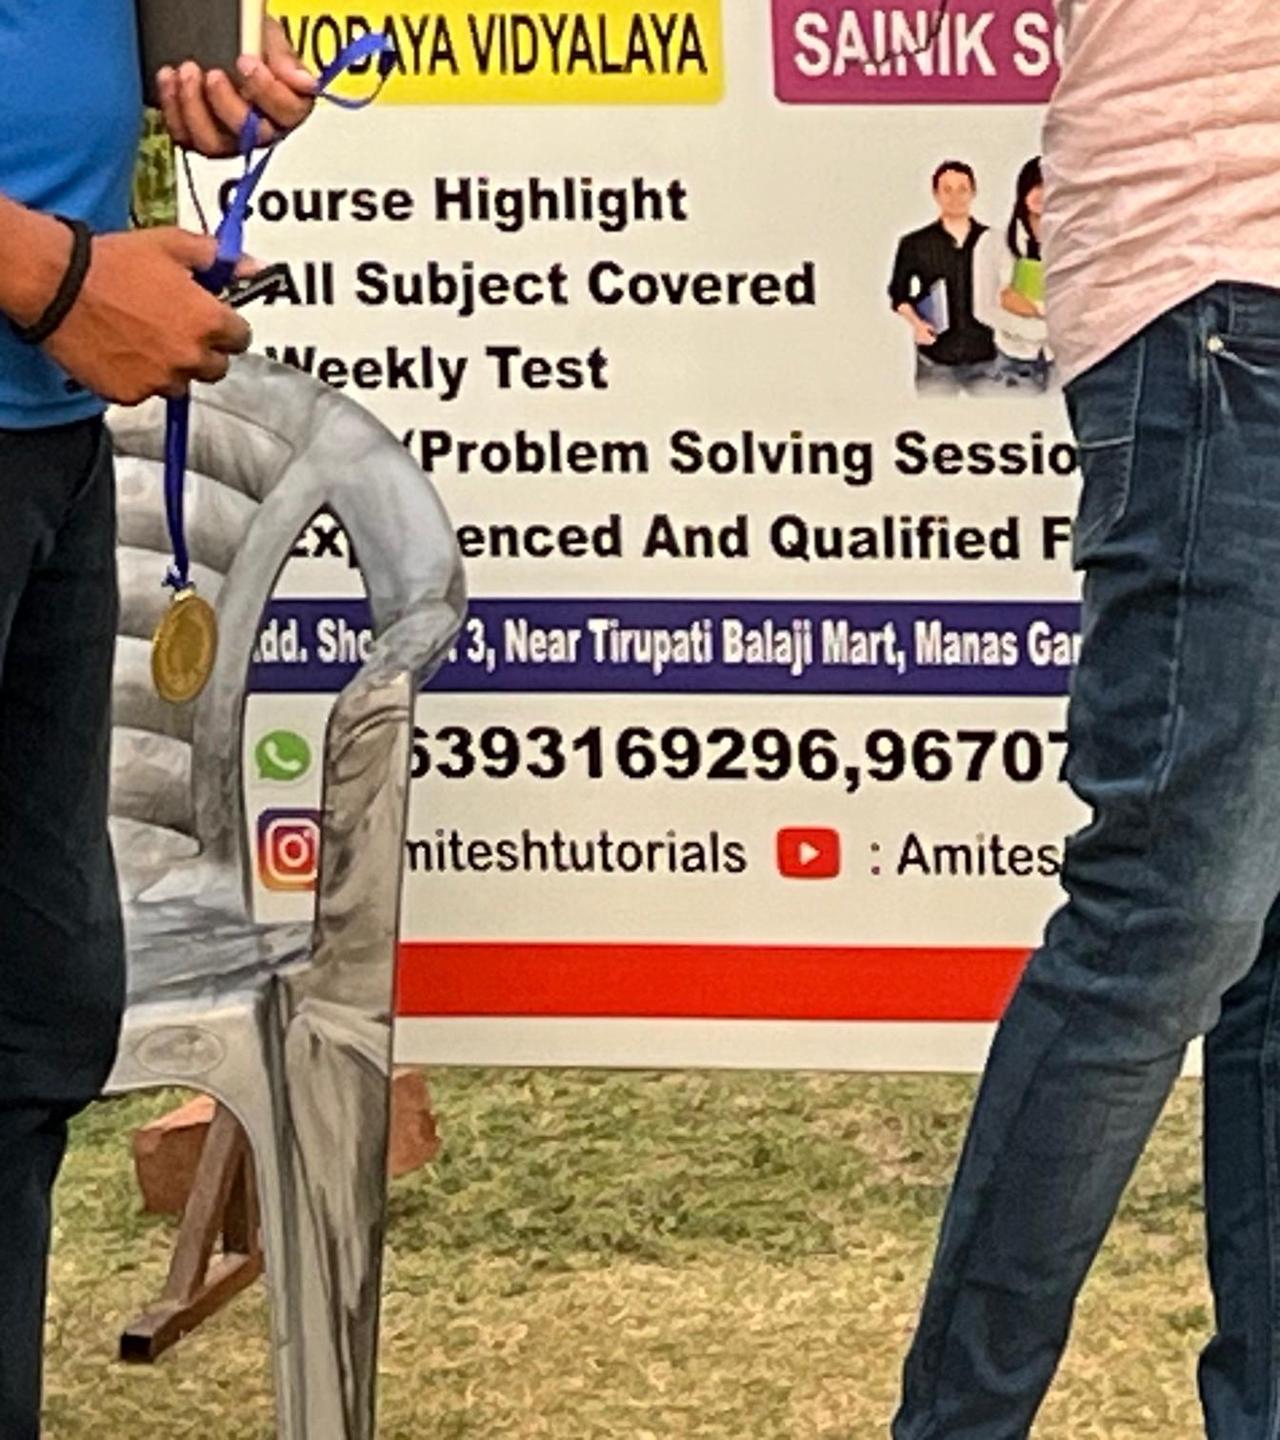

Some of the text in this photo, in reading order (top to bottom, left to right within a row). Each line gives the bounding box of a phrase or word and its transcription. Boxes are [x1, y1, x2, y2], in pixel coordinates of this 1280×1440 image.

[470, 13, 707, 75] VIDYALAYA
[794, 9, 1064, 76] SAINIK S
[218, 176, 687, 232] Course Highlight
[264, 261, 815, 316] All Subject Covered
[266, 346, 609, 401] Weekly Test
[671, 430, 872, 486] Solving
[895, 430, 1078, 475] Sessio
[643, 514, 748, 558] And
[770, 515, 1019, 561] Qualified
[252, 619, 307, 663] dd.
[467, 619, 495, 672] 3,
[505, 620, 581, 663] Near
[587, 618, 713, 676] Tirupati
[723, 619, 812, 676] Balaji
[822, 620, 906, 674] Mart,
[914, 620, 1018, 665] Manas
